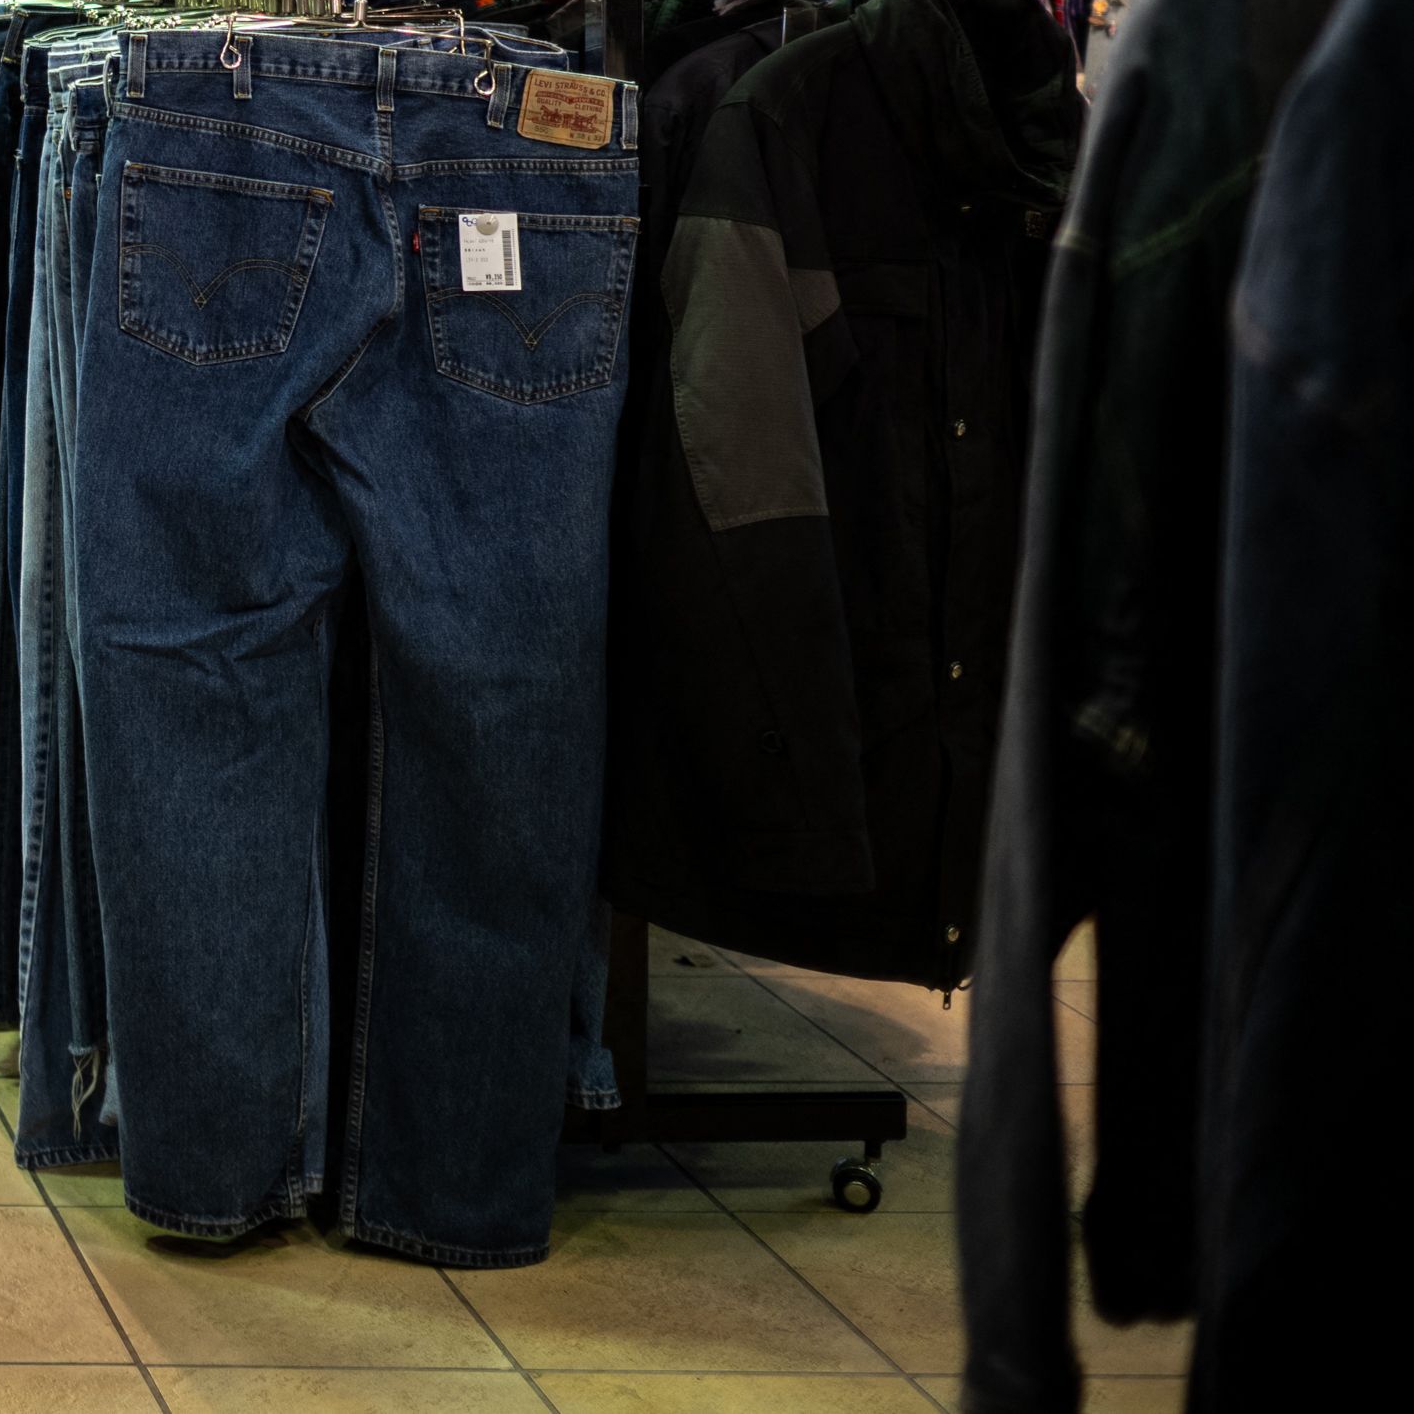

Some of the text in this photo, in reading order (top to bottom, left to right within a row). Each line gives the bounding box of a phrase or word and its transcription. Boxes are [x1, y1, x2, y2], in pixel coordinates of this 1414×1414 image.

[534, 78, 552, 89] LEVI
[555, 81, 588, 94] STRAUSS
[536, 97, 562, 107] QUALITY
